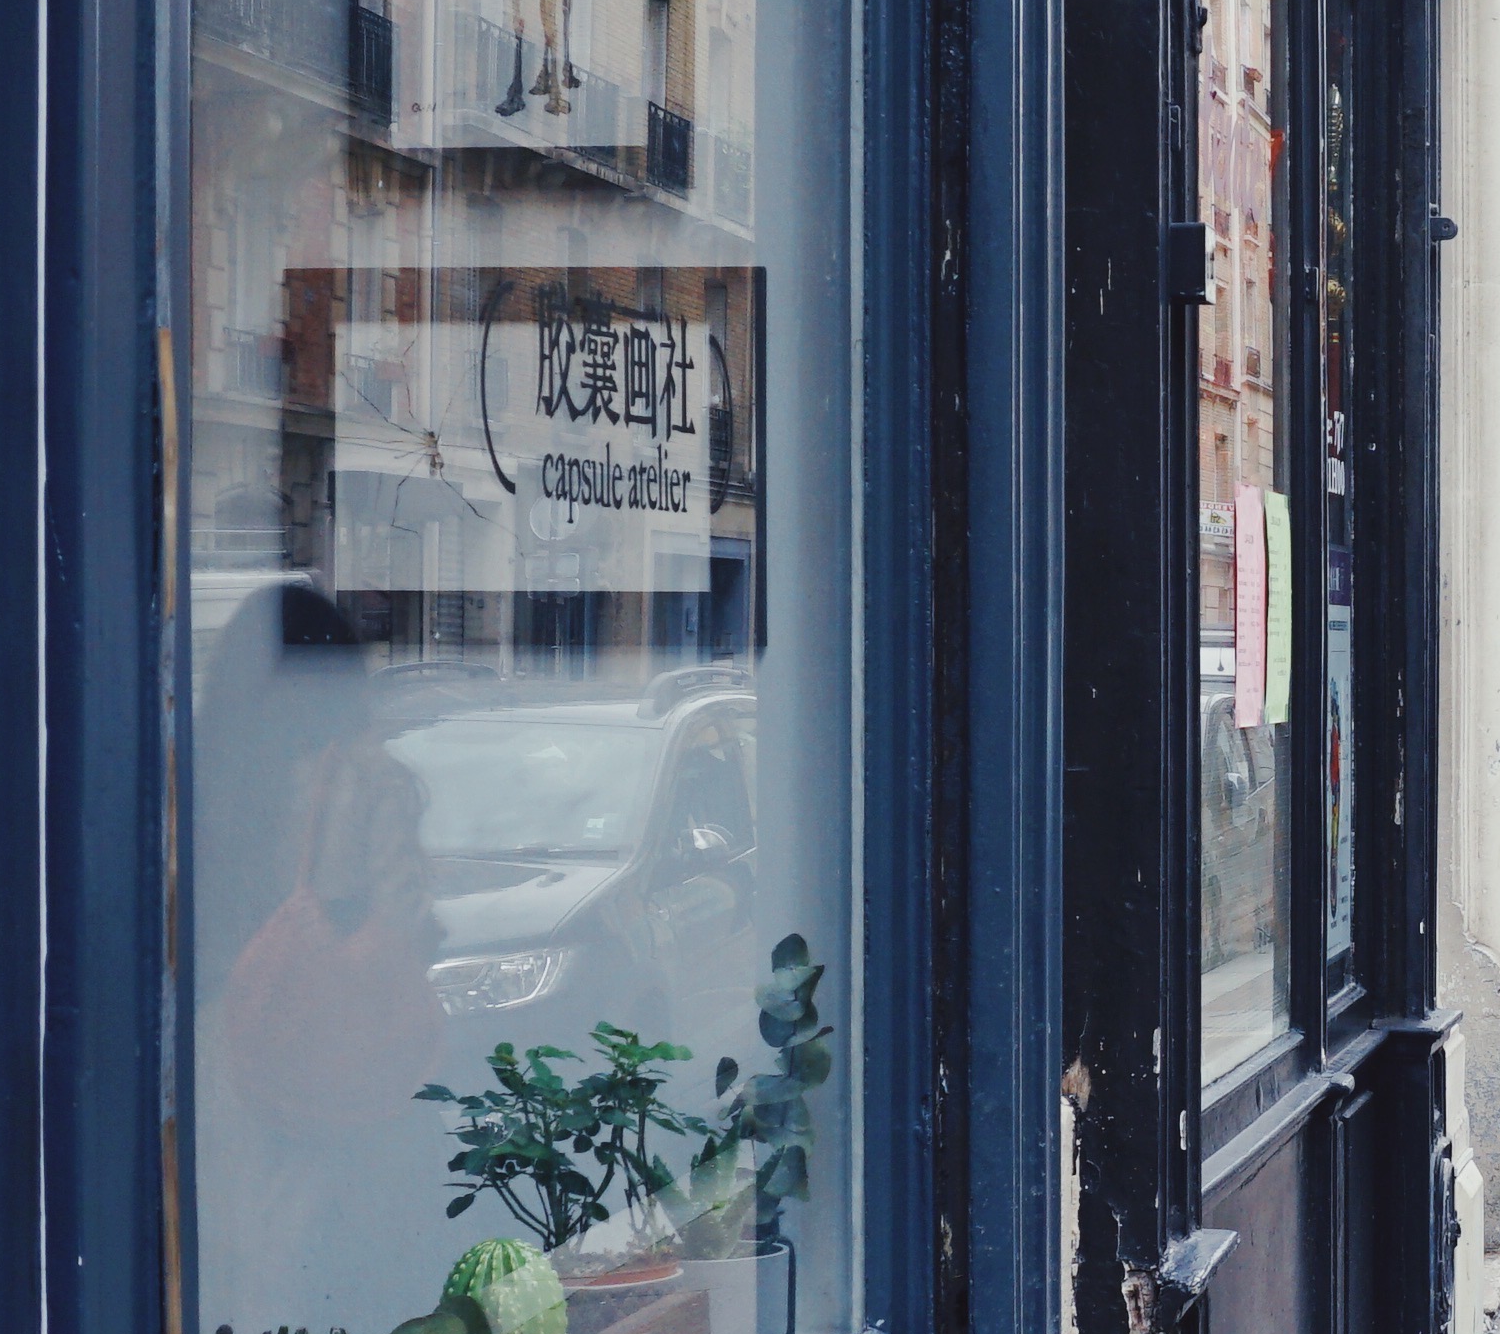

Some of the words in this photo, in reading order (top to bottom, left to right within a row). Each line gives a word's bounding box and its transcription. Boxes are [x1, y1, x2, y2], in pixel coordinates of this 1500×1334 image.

[536, 281, 696, 442] 胶囊画社
[542, 441, 625, 524] capsule
[628, 444, 692, 514] atelier
